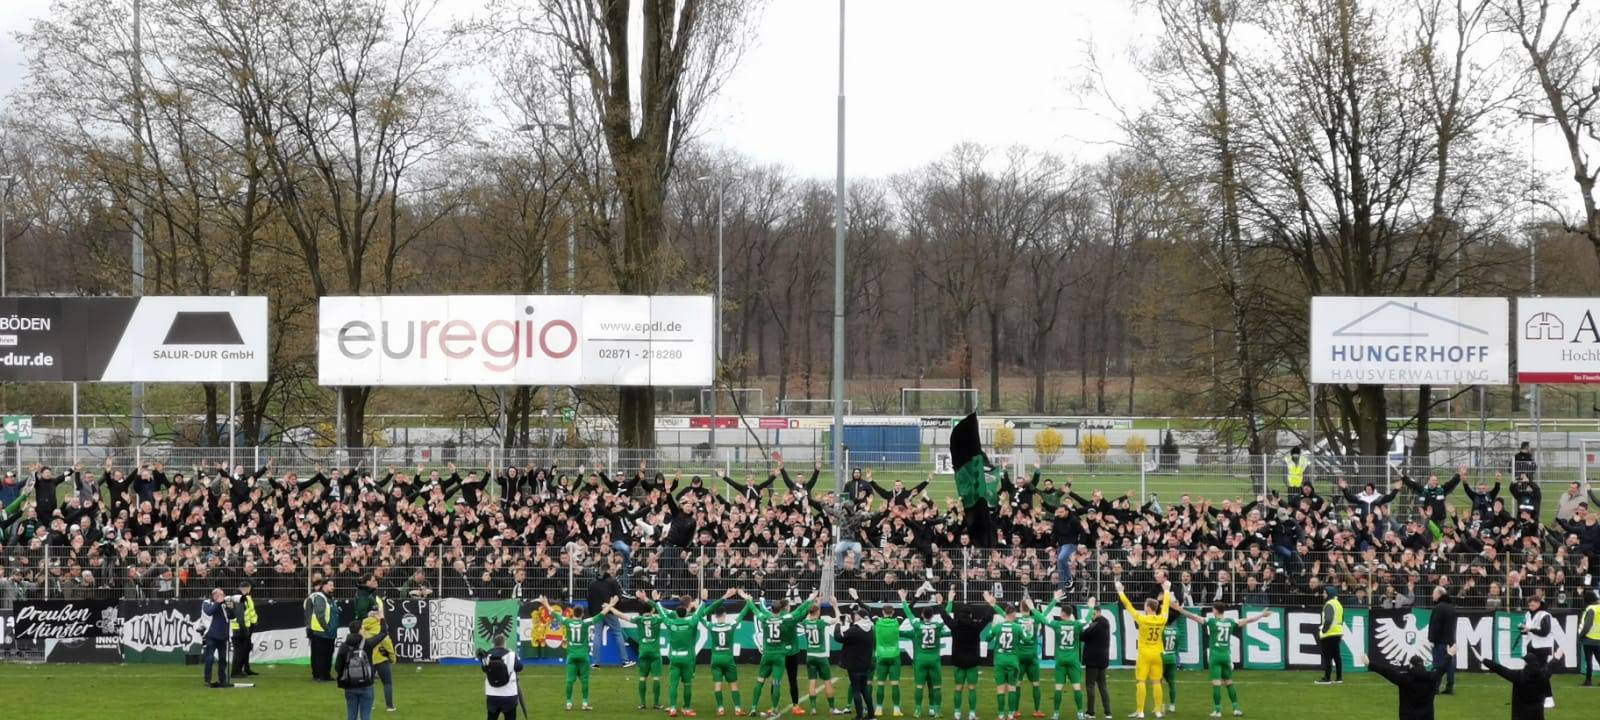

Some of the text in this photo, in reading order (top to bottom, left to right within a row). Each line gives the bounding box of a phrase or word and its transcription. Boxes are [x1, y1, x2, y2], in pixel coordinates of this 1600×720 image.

[0, 315, 51, 331] BÖDEN
[599, 320, 683, 333] www.epdl.de
[337, 305, 578, 372] euregio
[0, 352, 53, 366] -dur.de
[152, 350, 255, 360] SALUR-DUR GmbH
[598, 348, 631, 360] 02871
[642, 348, 683, 360] 218280
[1331, 345, 1489, 362] HUNGERHOFF
[1331, 368, 1490, 381] HAUSVERWALTUNG
[16, 604, 91, 624] Preußen
[429, 600, 447, 614] DE
[430, 613, 474, 631] BESTEN
[16, 621, 94, 639] Münster
[130, 615, 194, 647] LUNATICS
[397, 627, 419, 642] FAN
[431, 627, 452, 641] AUS
[570, 627, 581, 643] 11
[768, 624, 780, 639] 15
[805, 629, 819, 645] 20
[922, 629, 936, 644] 23
[1147, 627, 1160, 642] 35
[1217, 627, 1229, 642] 21
[999, 632, 1013, 649] 42
[1060, 630, 1074, 646] 24
[1456, 614, 1600, 671] MÜN
[394, 643, 423, 659] CLUB
[431, 642, 475, 657] WESTEN
